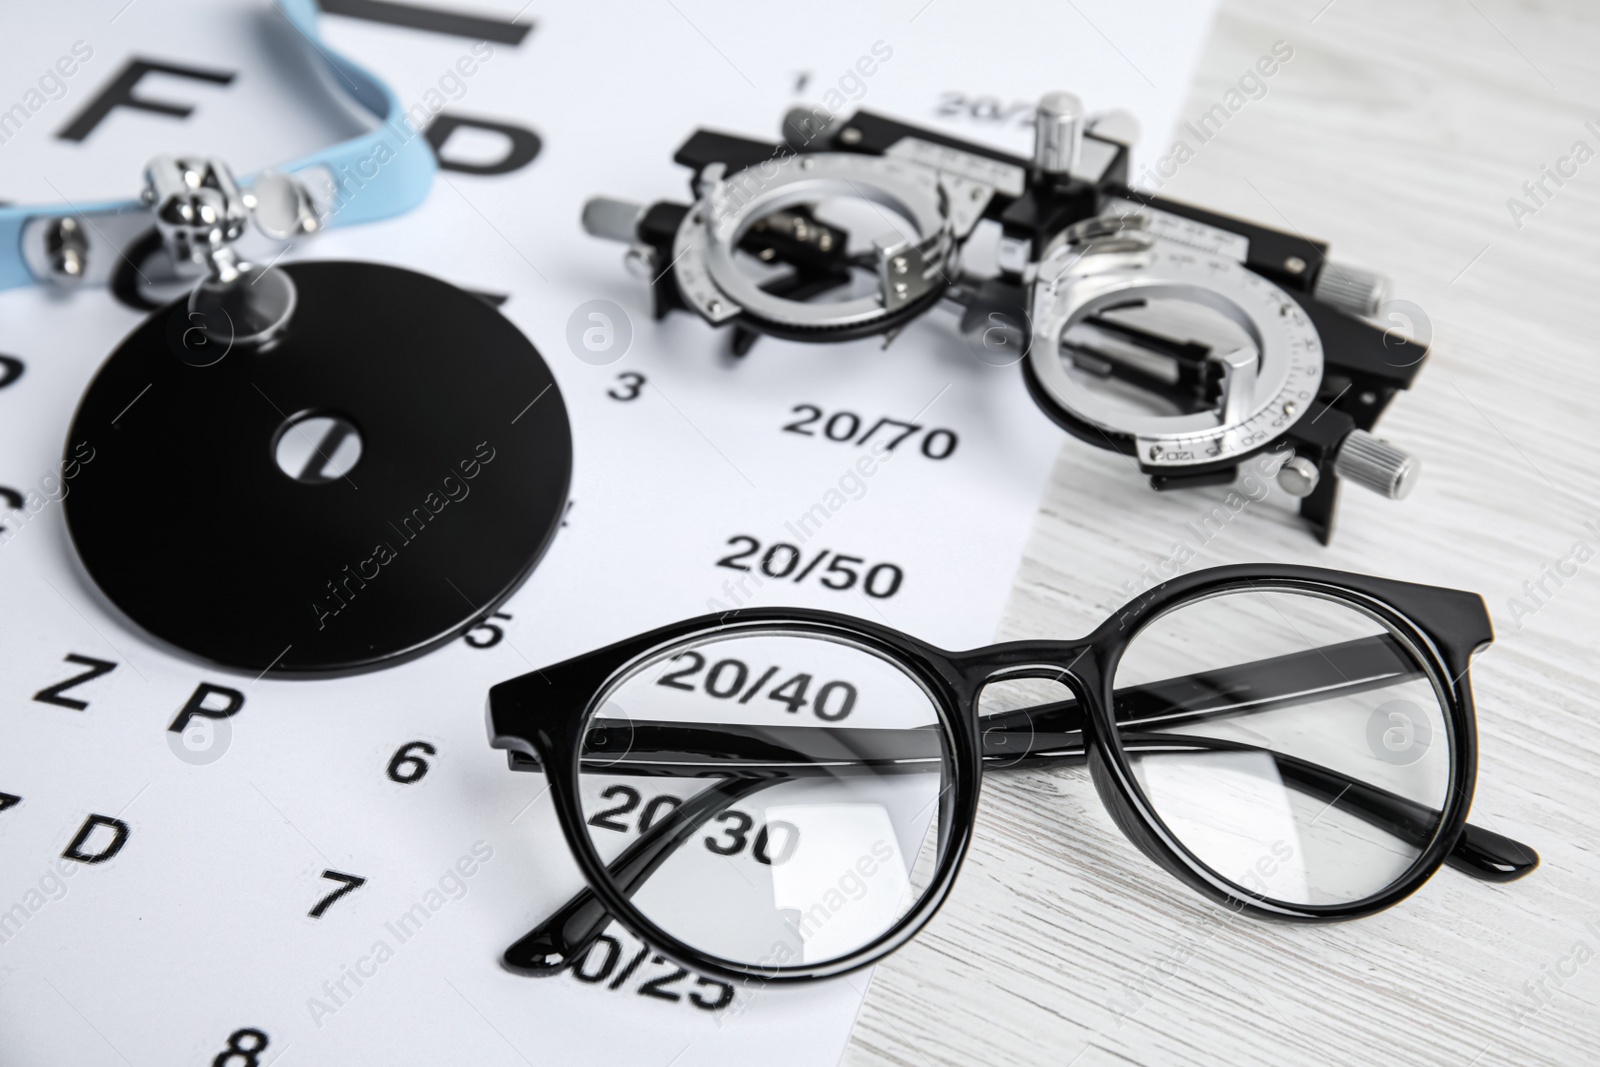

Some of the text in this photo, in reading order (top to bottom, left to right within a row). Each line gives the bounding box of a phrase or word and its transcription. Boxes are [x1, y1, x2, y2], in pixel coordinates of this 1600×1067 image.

[55, 56, 237, 141] F
[606, 371, 648, 402] 3
[781, 403, 959, 461] 20/70
[1166, 451, 1195, 461] 120
[1240, 429, 1269, 447] 150
[715, 534, 905, 600] 20/50
[32, 653, 246, 734] Z P
[656, 650, 859, 723] 20/40
[384, 740, 437, 786] 6
[60, 812, 132, 865] D
[307, 867, 368, 919] 7
[211, 1027, 270, 1067] 8
